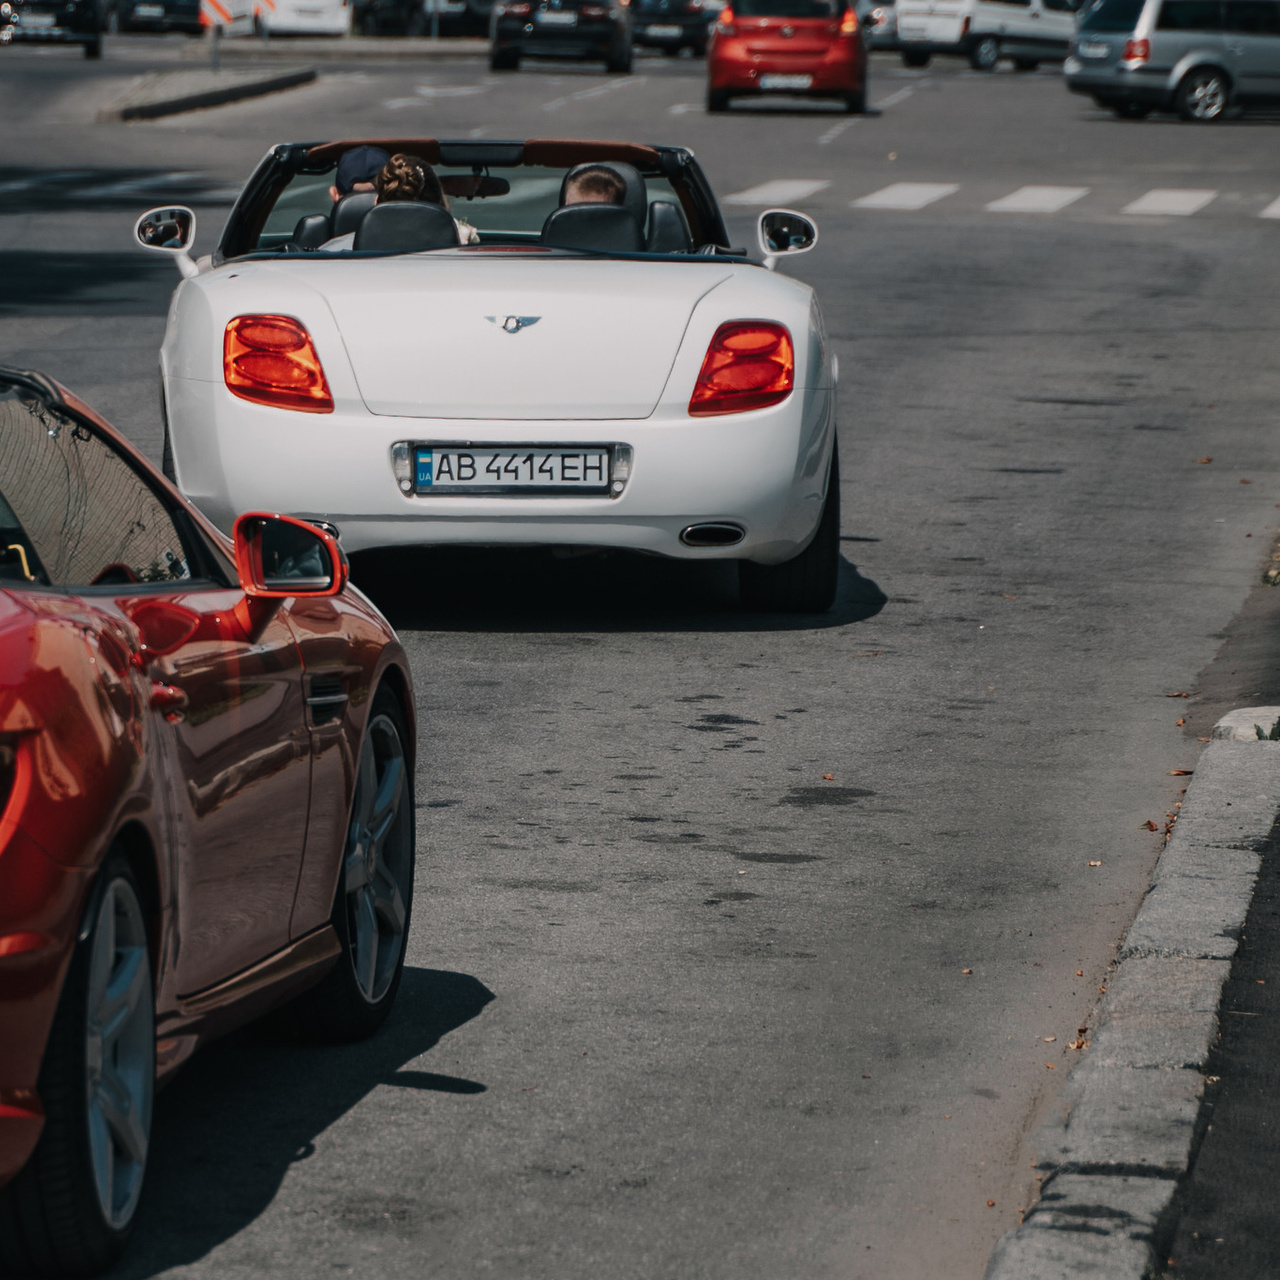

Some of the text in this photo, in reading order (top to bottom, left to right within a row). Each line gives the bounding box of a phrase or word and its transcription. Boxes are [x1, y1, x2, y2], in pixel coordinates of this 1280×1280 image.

[435, 453, 603, 481] AB 4414 EH
[419, 472, 431, 481] UA
